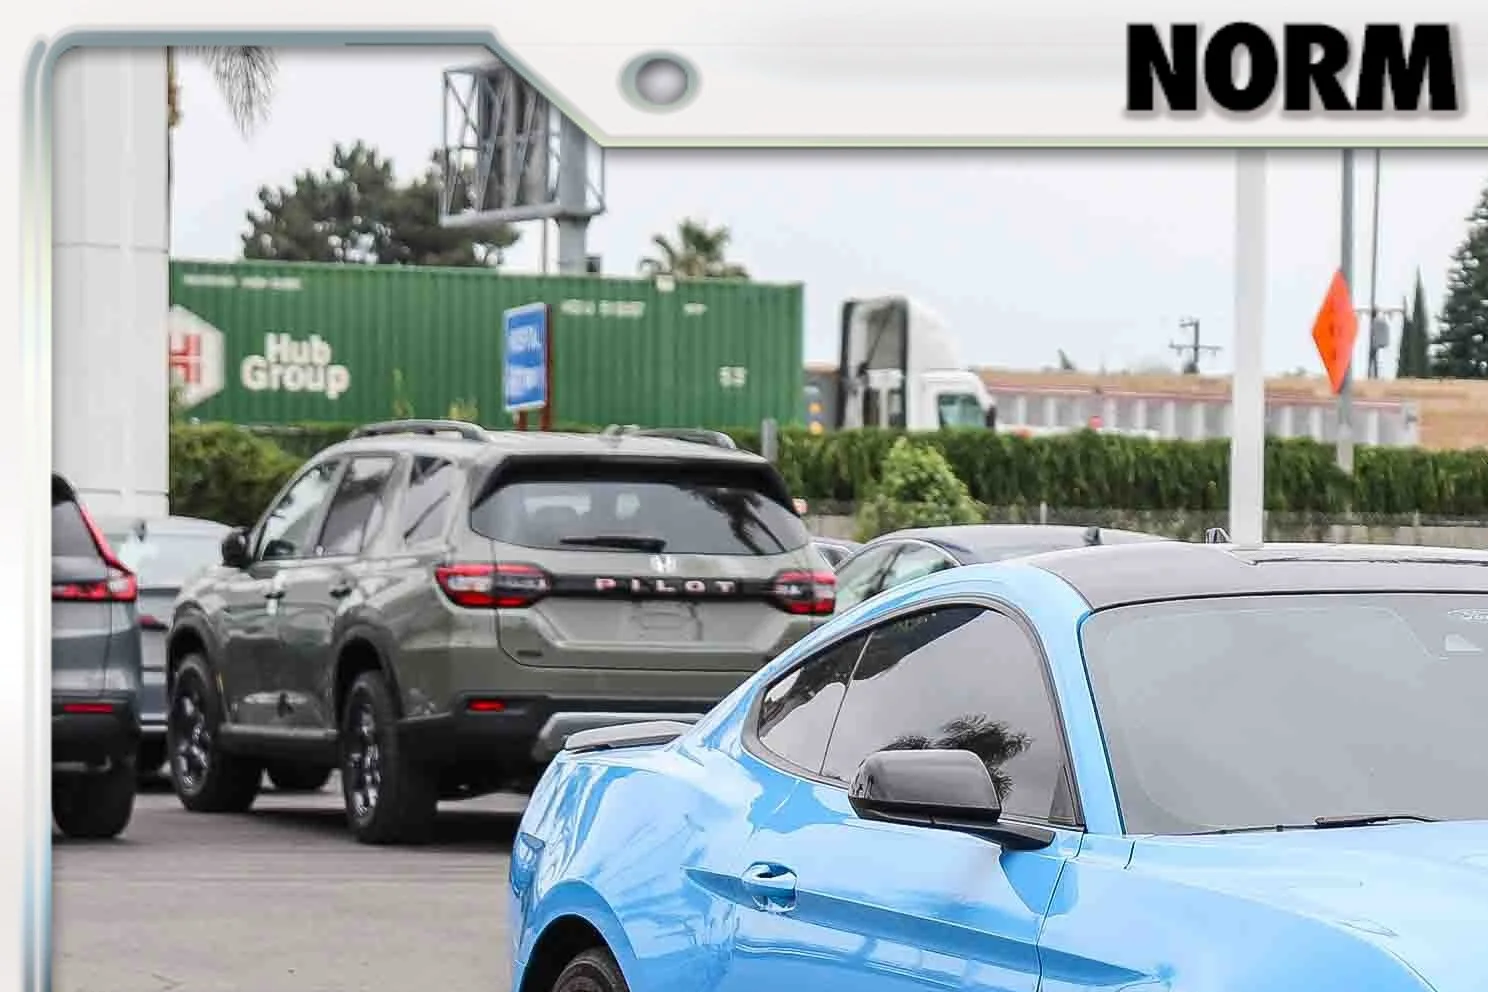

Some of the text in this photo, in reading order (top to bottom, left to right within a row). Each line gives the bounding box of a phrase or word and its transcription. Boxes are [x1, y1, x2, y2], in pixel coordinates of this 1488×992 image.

[264, 332, 332, 364] Hub
[240, 355, 350, 400] Group
[595, 578, 735, 592] PILOT
